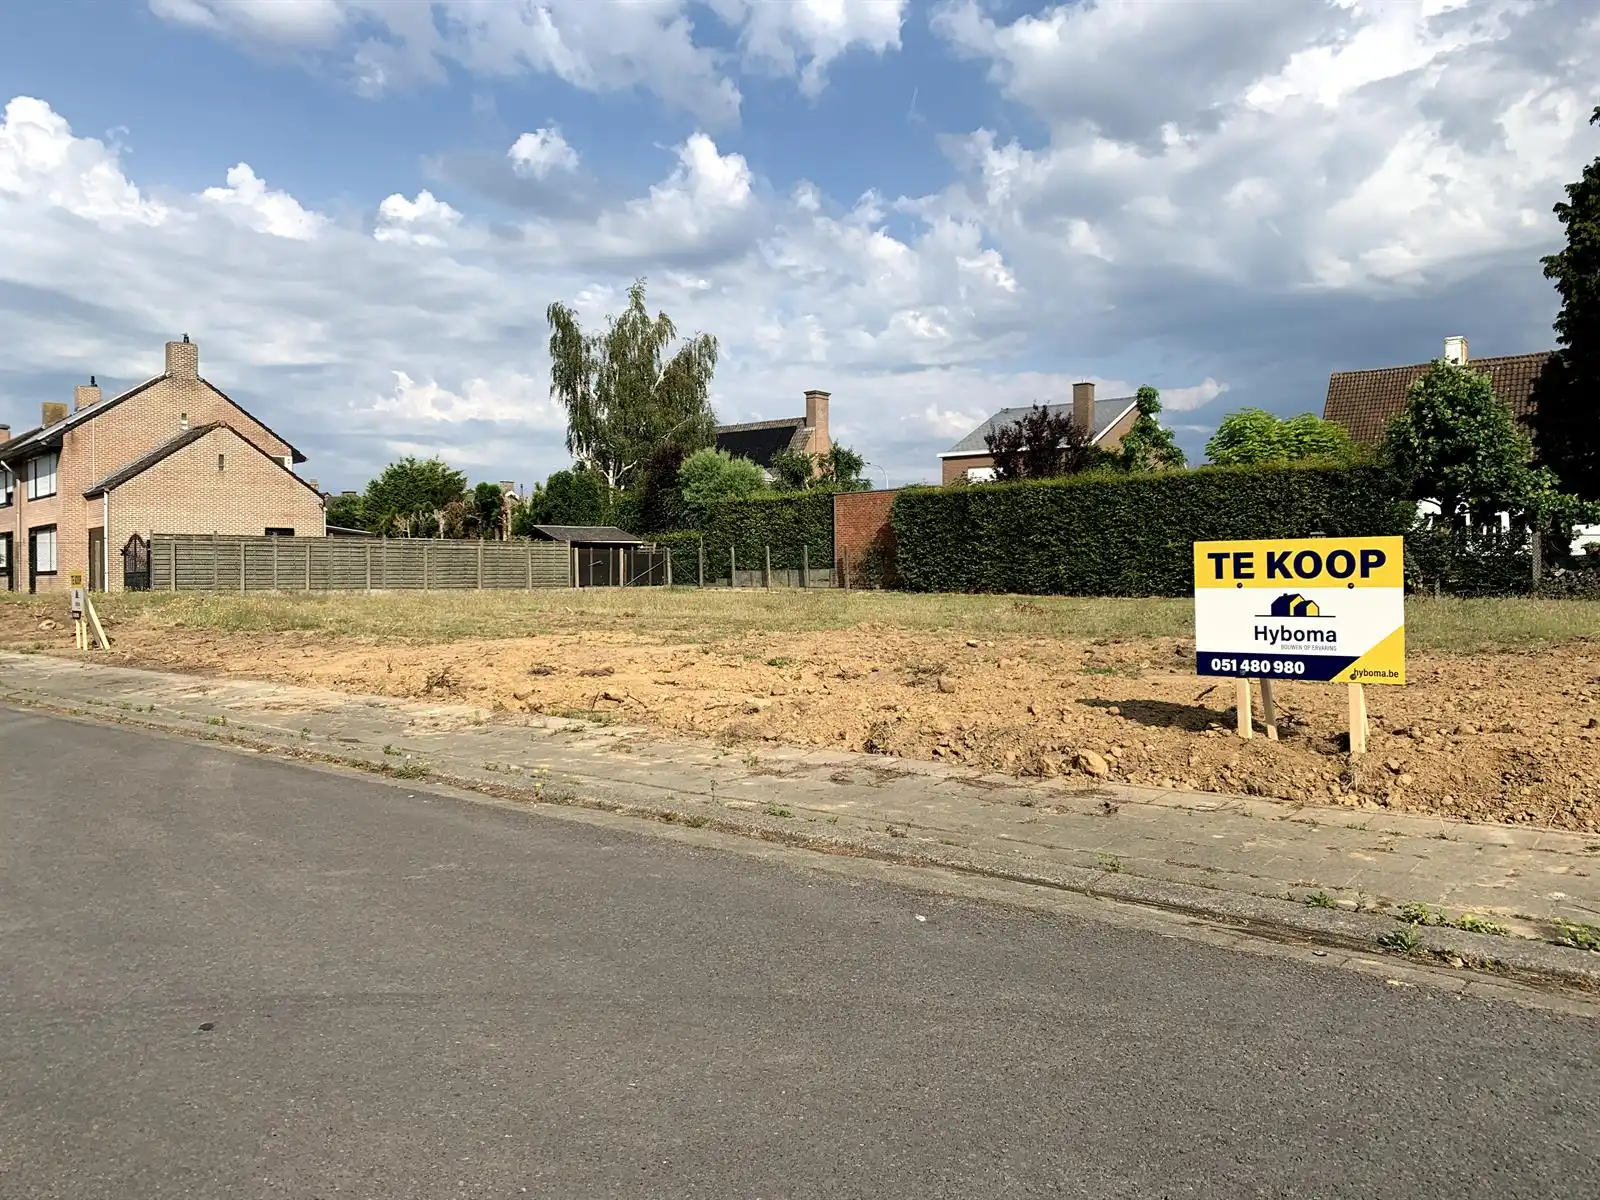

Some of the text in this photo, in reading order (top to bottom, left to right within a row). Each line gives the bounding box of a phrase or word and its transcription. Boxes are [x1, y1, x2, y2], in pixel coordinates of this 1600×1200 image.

[1208, 549, 1386, 579] TE KOOP
[1254, 625, 1337, 645] Hyboma
[1211, 658, 1305, 674] 051 480 980
[1353, 668, 1399, 679] hyboma.be
